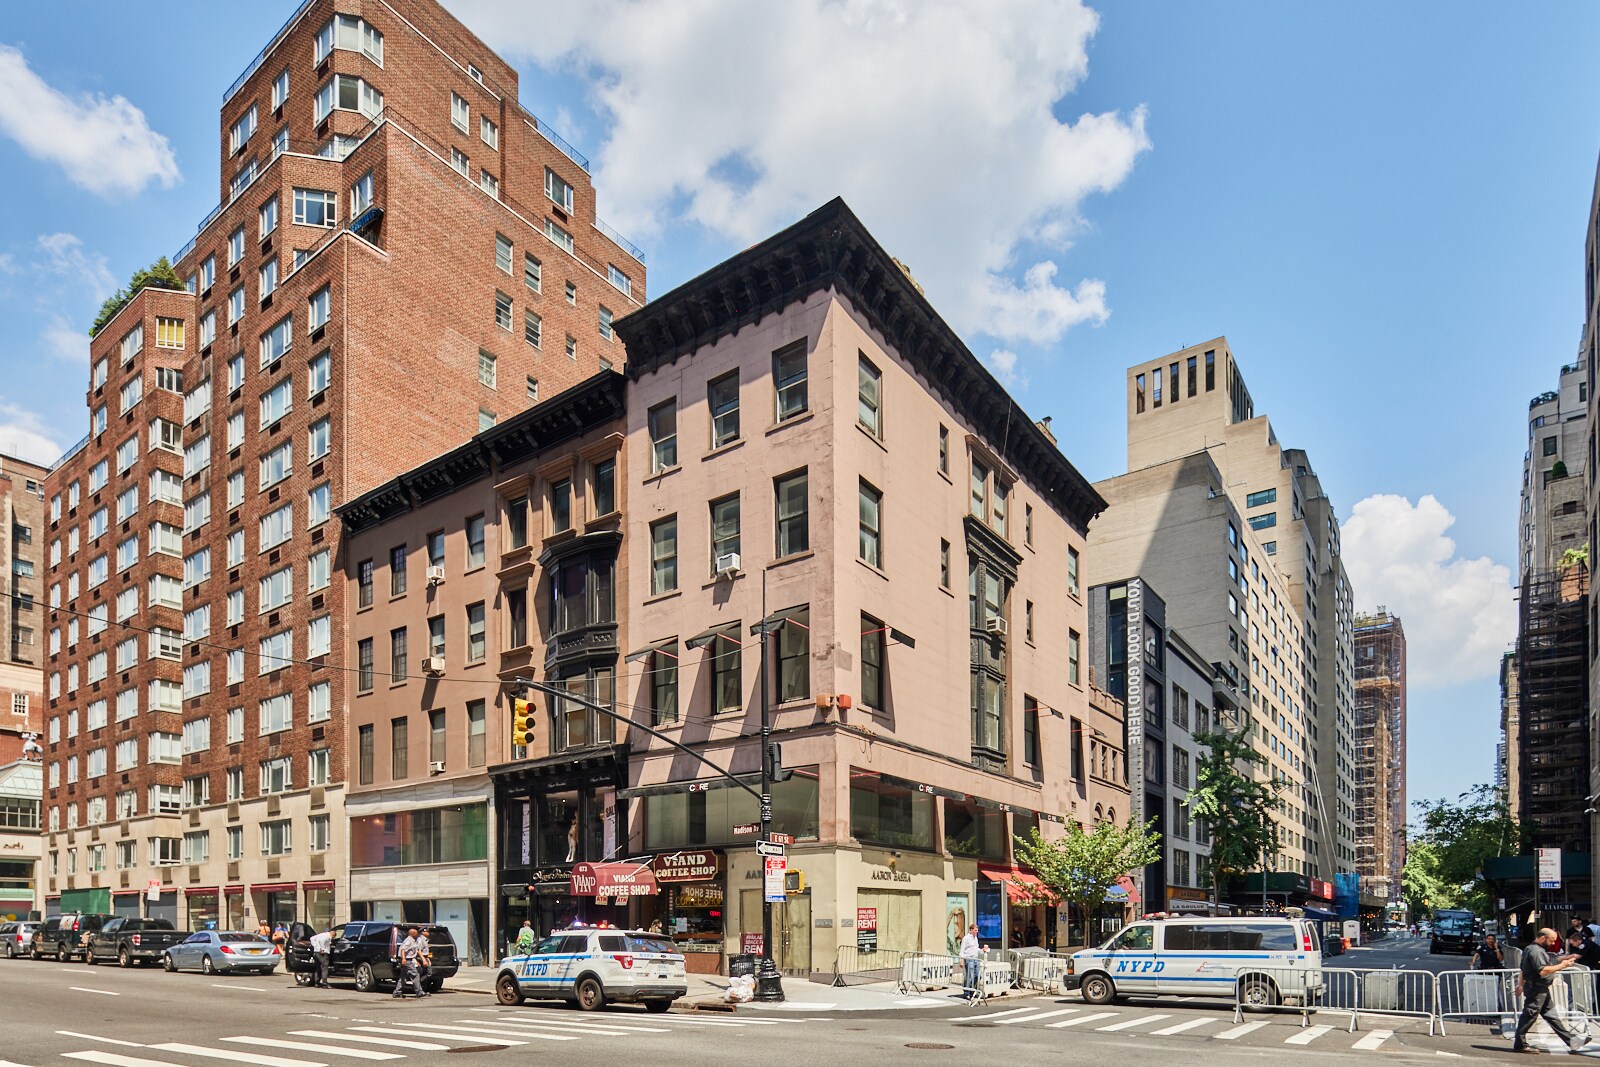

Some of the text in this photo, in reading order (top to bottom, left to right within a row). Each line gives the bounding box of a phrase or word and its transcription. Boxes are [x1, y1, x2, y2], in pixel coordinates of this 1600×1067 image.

[1127, 579, 1141, 746] YOU'D LOOK GOOD HERE
[689, 783, 709, 792] CORE
[733, 825, 752, 834] Madison
[774, 834, 778, 843] E
[778, 835, 784, 843] 61
[663, 854, 707, 867] VIAND
[655, 866, 716, 878] COFFEE SHOP
[871, 870, 892, 881] AARON
[572, 874, 597, 894] VIAND
[613, 874, 636, 883] VIAND
[598, 884, 651, 897] COFFEE SHOP
[857, 919, 877, 929] RENT
[744, 944, 763, 953] REN
[525, 963, 548, 977] NYPD
[1117, 960, 1166, 973] NYPD
[988, 971, 1008, 984] NYPD
